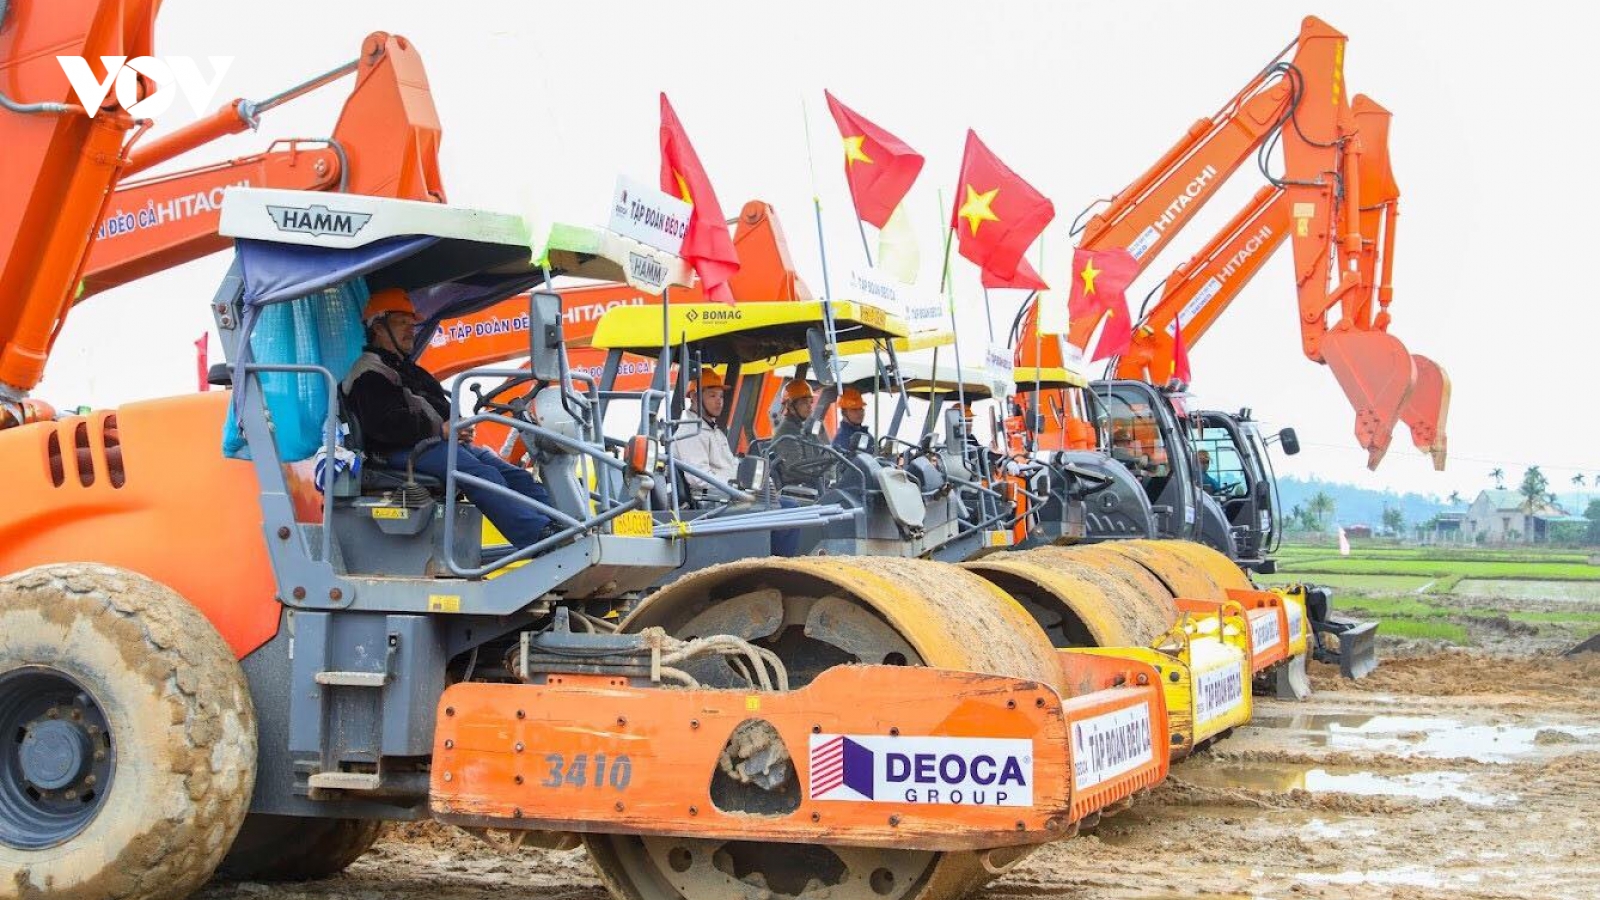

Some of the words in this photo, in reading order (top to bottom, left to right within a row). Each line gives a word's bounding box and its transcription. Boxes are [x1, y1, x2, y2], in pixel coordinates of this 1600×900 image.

[1154, 165, 1217, 231] HITACHI
[283, 211, 352, 233] HAMM
[630, 199, 646, 225] TẬP
[645, 206, 665, 231] ĐOÀN
[1216, 225, 1273, 283] HITACHI
[634, 258, 661, 284] HAMM
[450, 322, 471, 343] TẬP
[476, 317, 509, 337] ĐOÀN
[513, 311, 529, 331] ĐÈ
[702, 310, 742, 320] BOMAG
[1089, 723, 1105, 783] TẬP
[1105, 716, 1128, 768] ĐOÀN
[541, 752, 632, 792] 3410
[886, 753, 1027, 786] DEOCA
[904, 788, 1008, 806] GROUP
